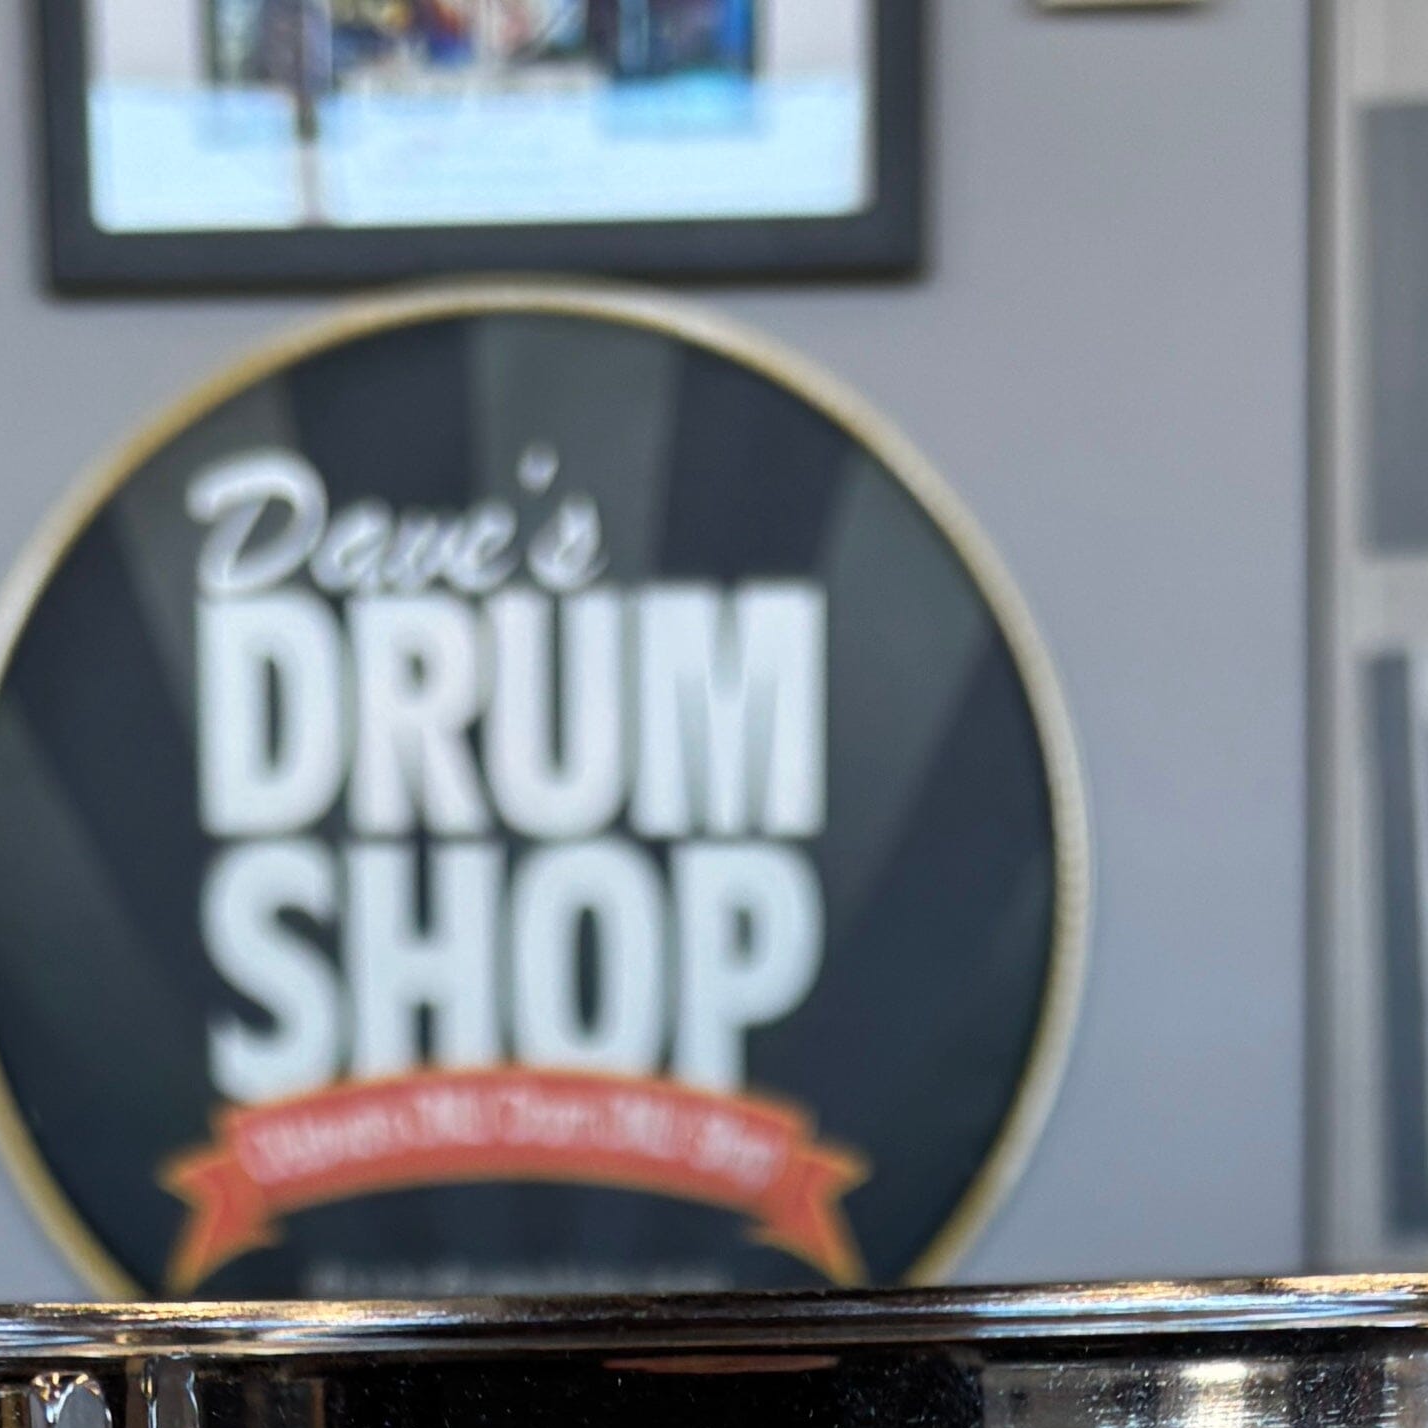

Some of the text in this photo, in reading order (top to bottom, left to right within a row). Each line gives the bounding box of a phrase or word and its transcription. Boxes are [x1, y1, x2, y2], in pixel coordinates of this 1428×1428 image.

[184, 444, 604, 590] Dave's
[196, 580, 826, 838] DRUM
[200, 840, 824, 1106] SHOP
